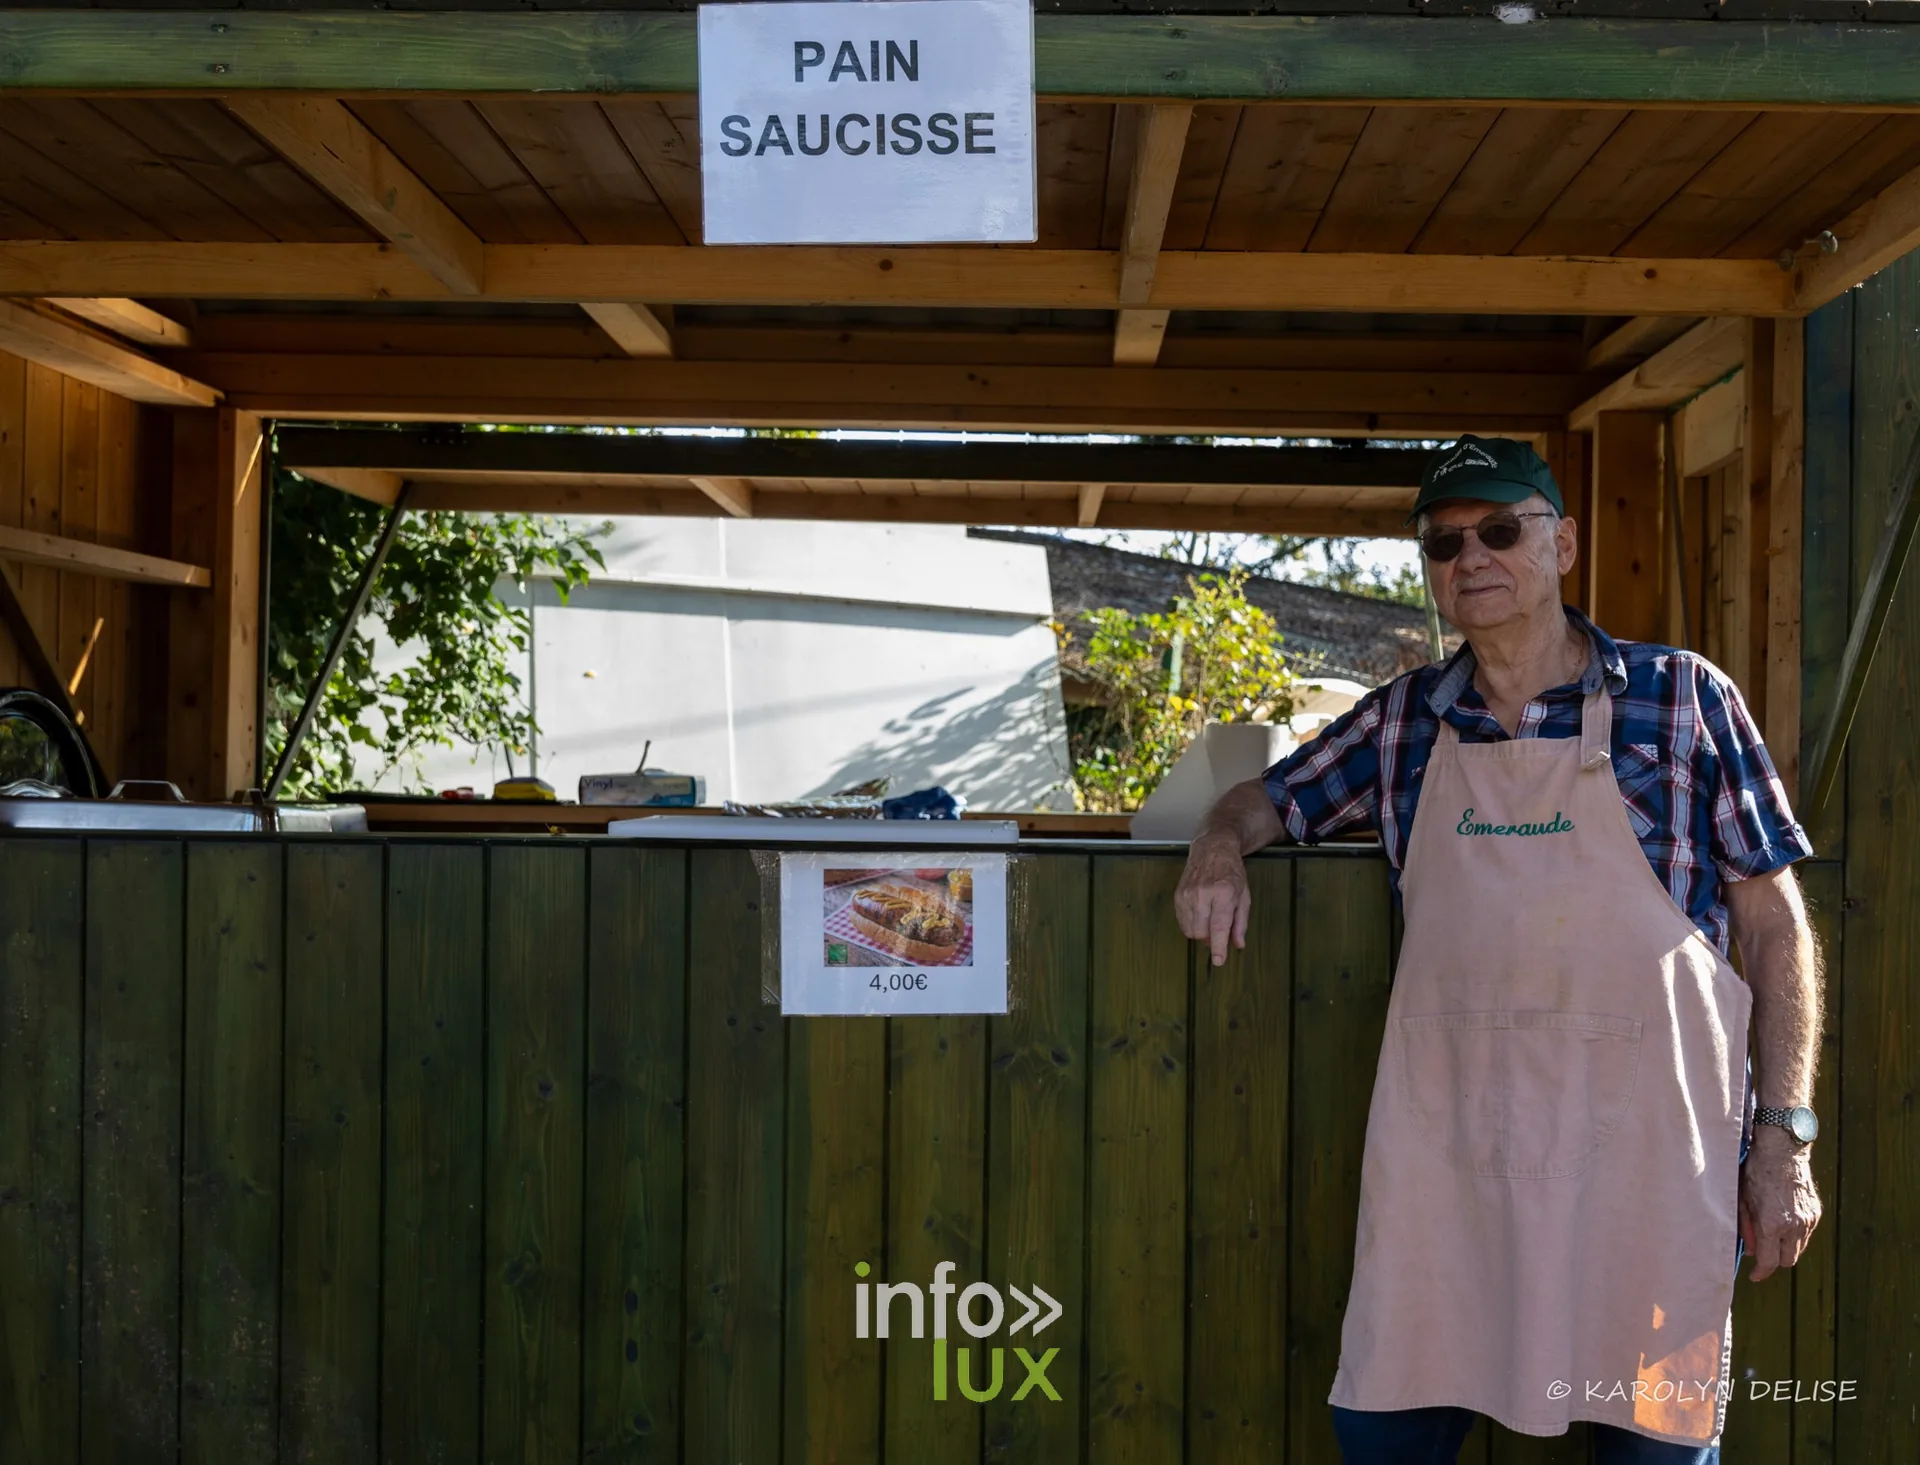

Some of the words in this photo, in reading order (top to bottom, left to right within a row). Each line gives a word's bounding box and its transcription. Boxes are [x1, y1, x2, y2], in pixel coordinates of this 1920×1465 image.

[794, 40, 919, 82] PAIN
[719, 112, 996, 156] SAUCISSE
[584, 779, 613, 790] Vinyl
[1456, 808, 1575, 836] Emeraude
[869, 973, 928, 993] 4,00€
